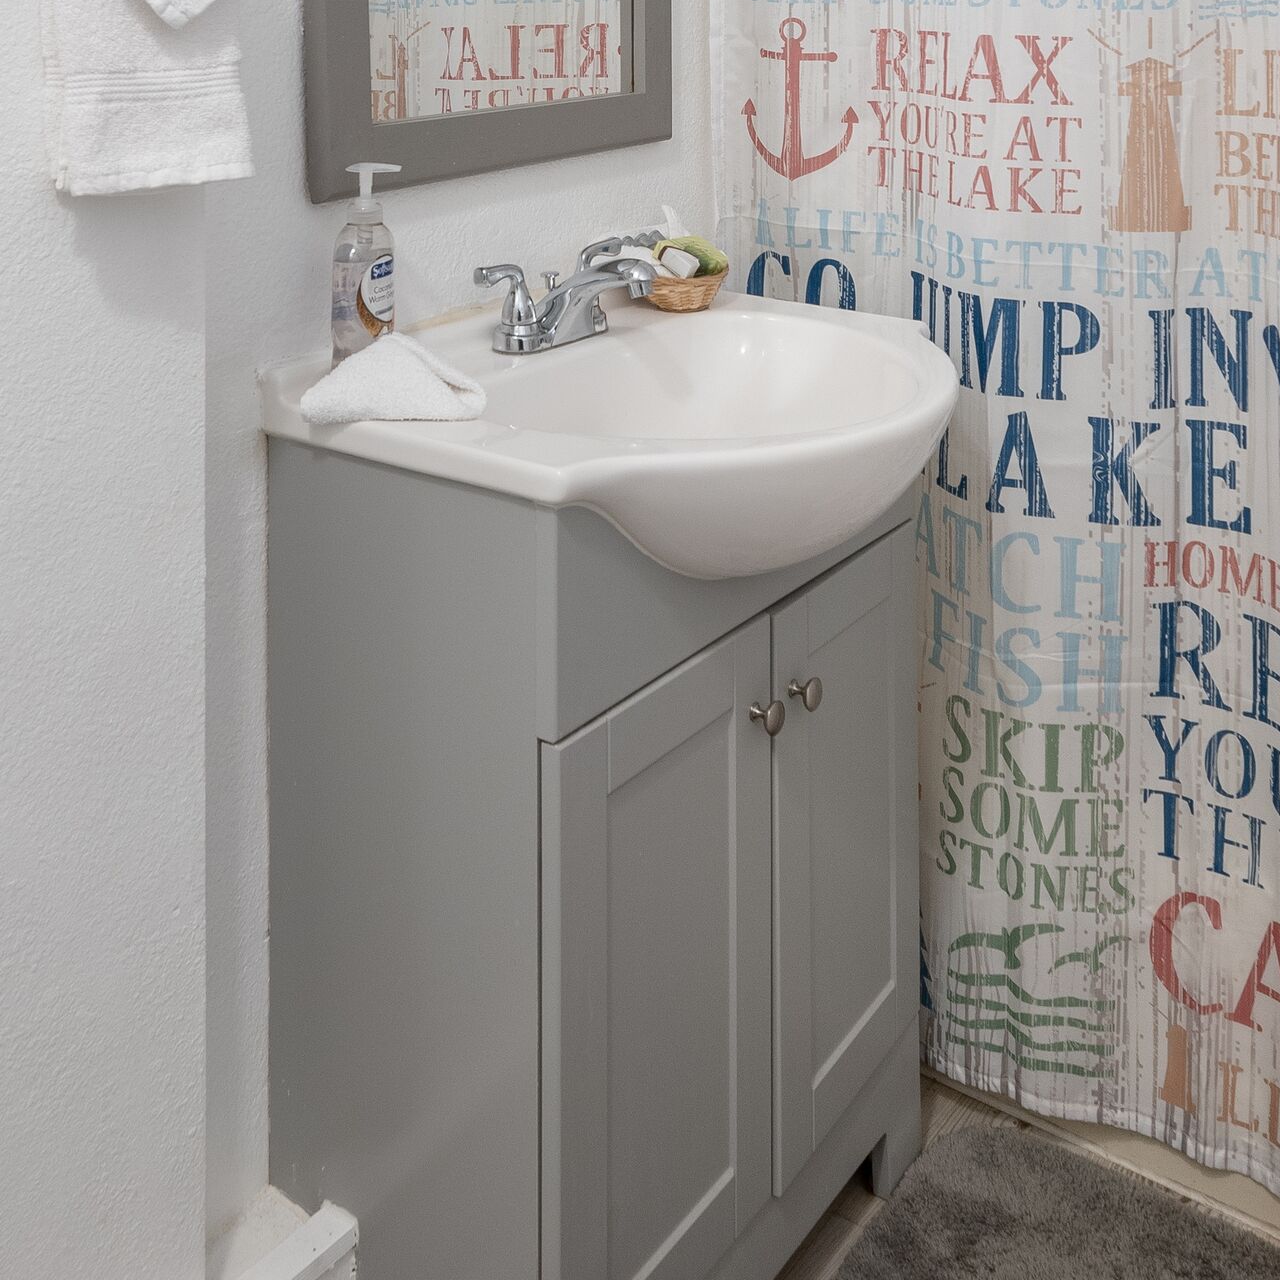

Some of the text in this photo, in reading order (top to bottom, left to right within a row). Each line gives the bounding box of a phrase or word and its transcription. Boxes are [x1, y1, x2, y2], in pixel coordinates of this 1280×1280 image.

[870, 27, 1074, 107] RELAX
[866, 99, 1083, 163] YOU'RE AT
[866, 144, 1083, 216] THE LAKE
[783, 207, 901, 257] LIFE
[945, 232, 1172, 300] BETTER
[1147, 305, 1253, 413] IN
[936, 410, 1253, 535] LAKE
[914, 492, 1128, 625] ATCH
[927, 588, 1128, 714] FISH
[942, 694, 1126, 795] SKIP
[939, 765, 1126, 859] SOME
[935, 828, 1137, 917] STONES
